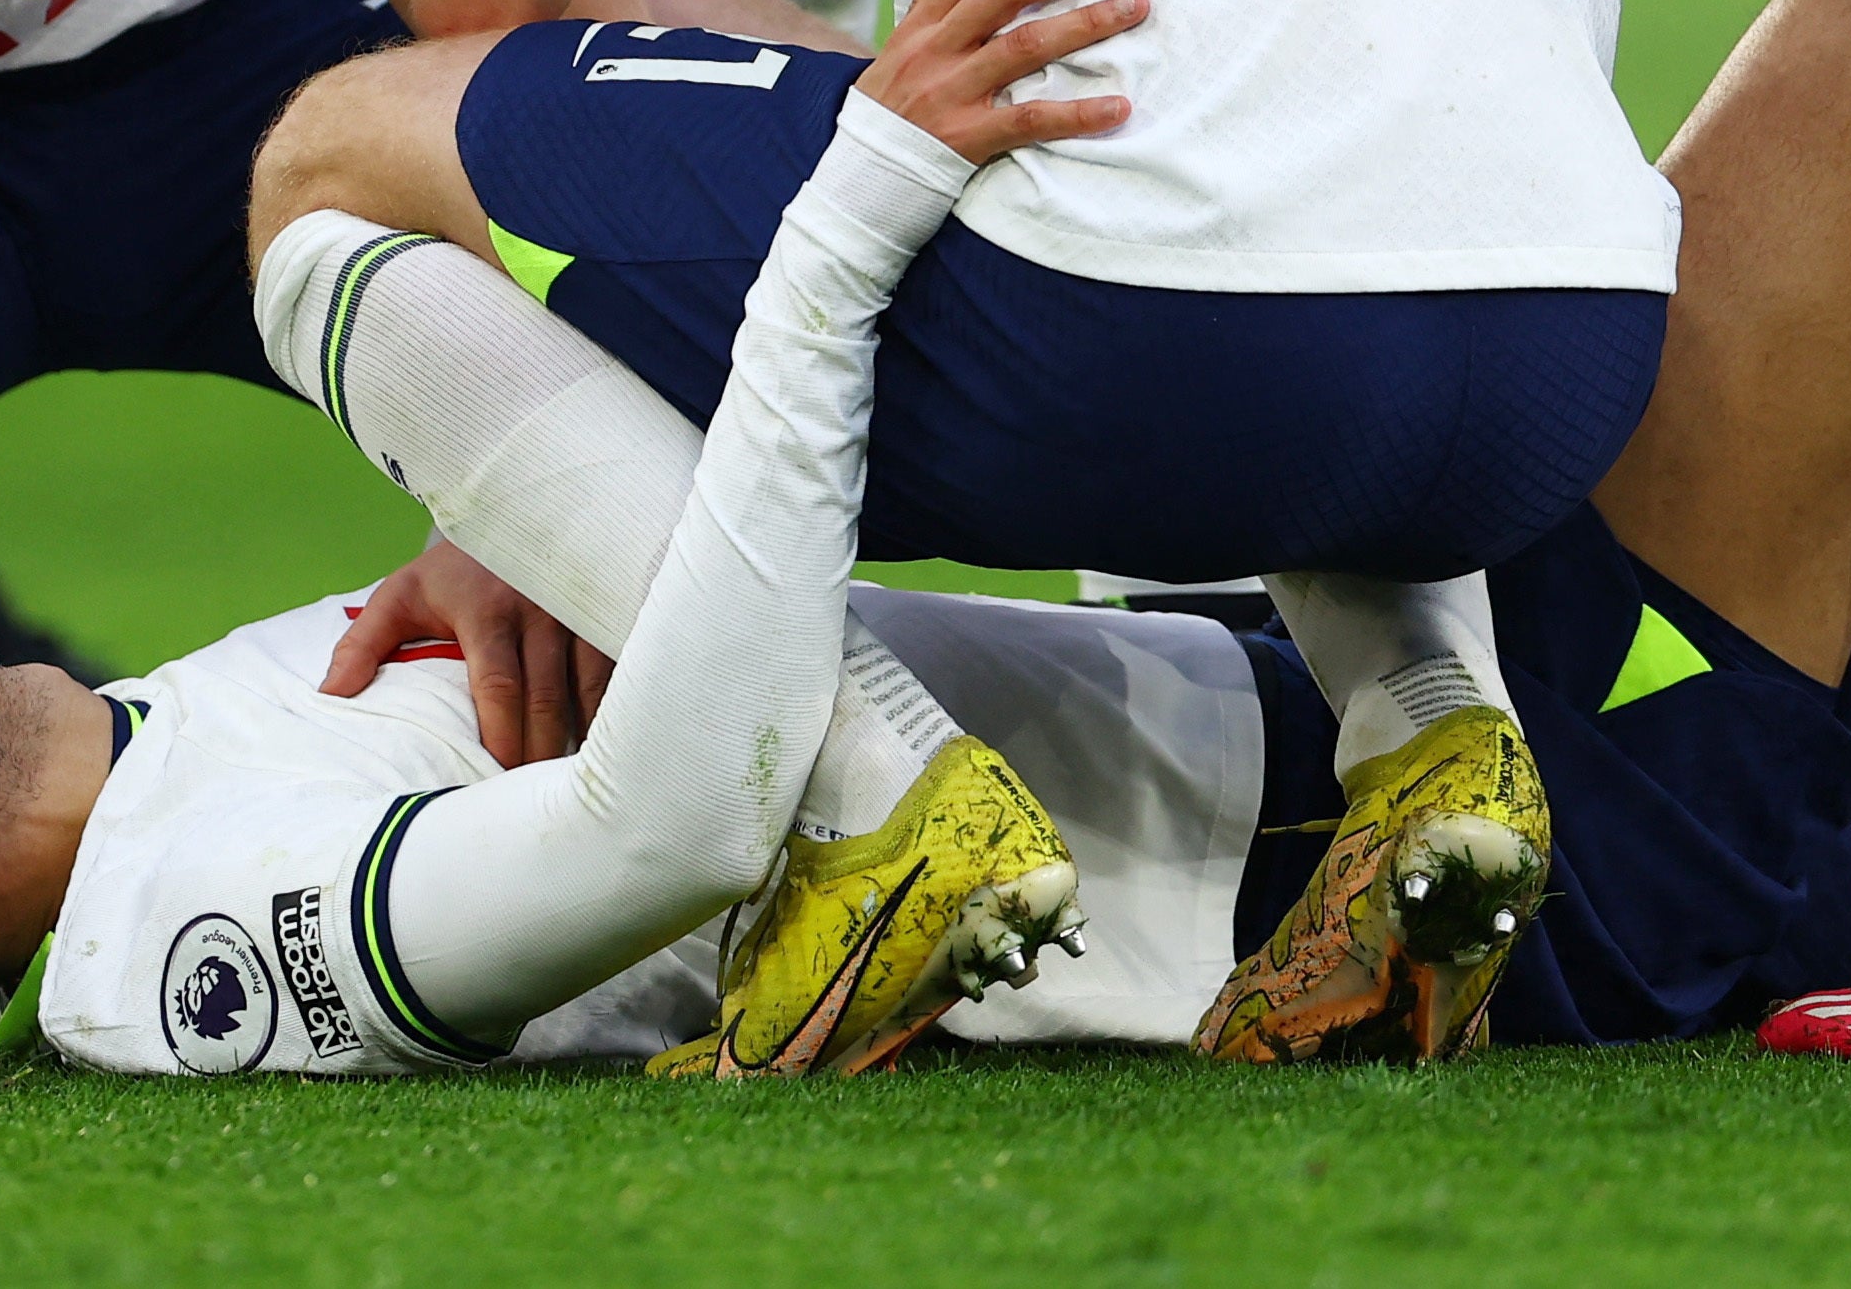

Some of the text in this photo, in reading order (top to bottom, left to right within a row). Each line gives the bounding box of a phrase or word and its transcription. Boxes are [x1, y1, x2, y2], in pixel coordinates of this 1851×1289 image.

[201, 929, 264, 996] Premier League
[278, 907, 344, 1057] No room
[299, 887, 362, 1050] for racism
